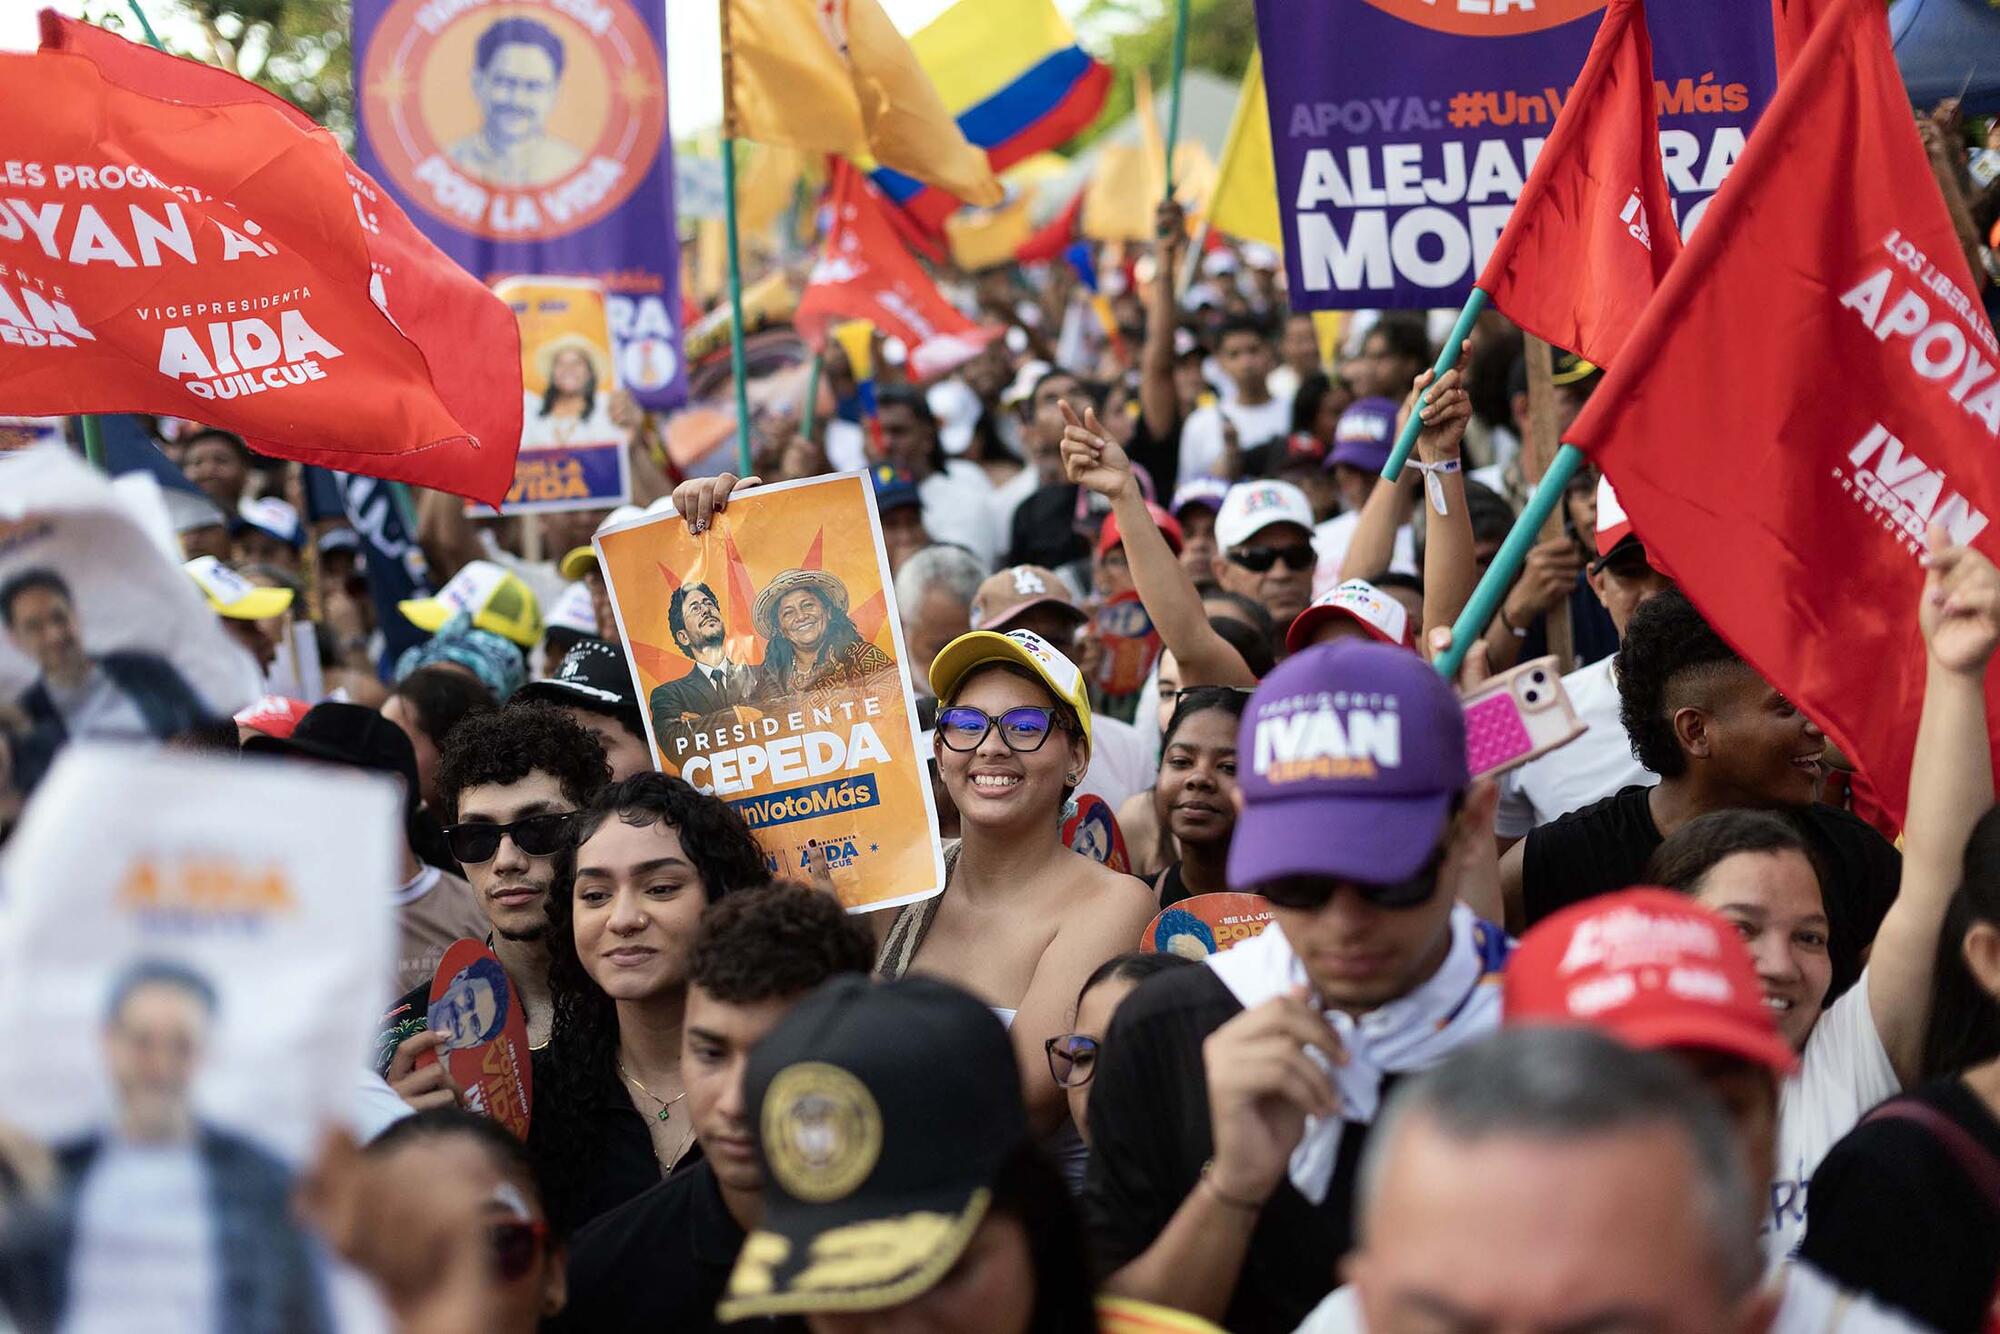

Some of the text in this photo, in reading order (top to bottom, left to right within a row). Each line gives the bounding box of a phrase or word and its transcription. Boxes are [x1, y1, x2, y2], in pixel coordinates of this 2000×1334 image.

[1288, 97, 1443, 137] APOYA:
[414, 155, 489, 222] POR
[489, 193, 541, 231] LA
[541, 155, 625, 223] VIDA
[1884, 229, 1927, 272] LOS
[137, 286, 312, 321] VICEPRESIDENTA
[158, 309, 345, 381] AIDA
[185, 358, 328, 400] QUILCUÉ
[1010, 566, 1047, 595] LA
[675, 696, 881, 755] PRESIDENTE
[681, 721, 893, 797] CEPEDA
[1223, 914, 1239, 925] ME
[1240, 912, 1255, 923] LA
[516, 1078, 529, 1115] JUEGO
